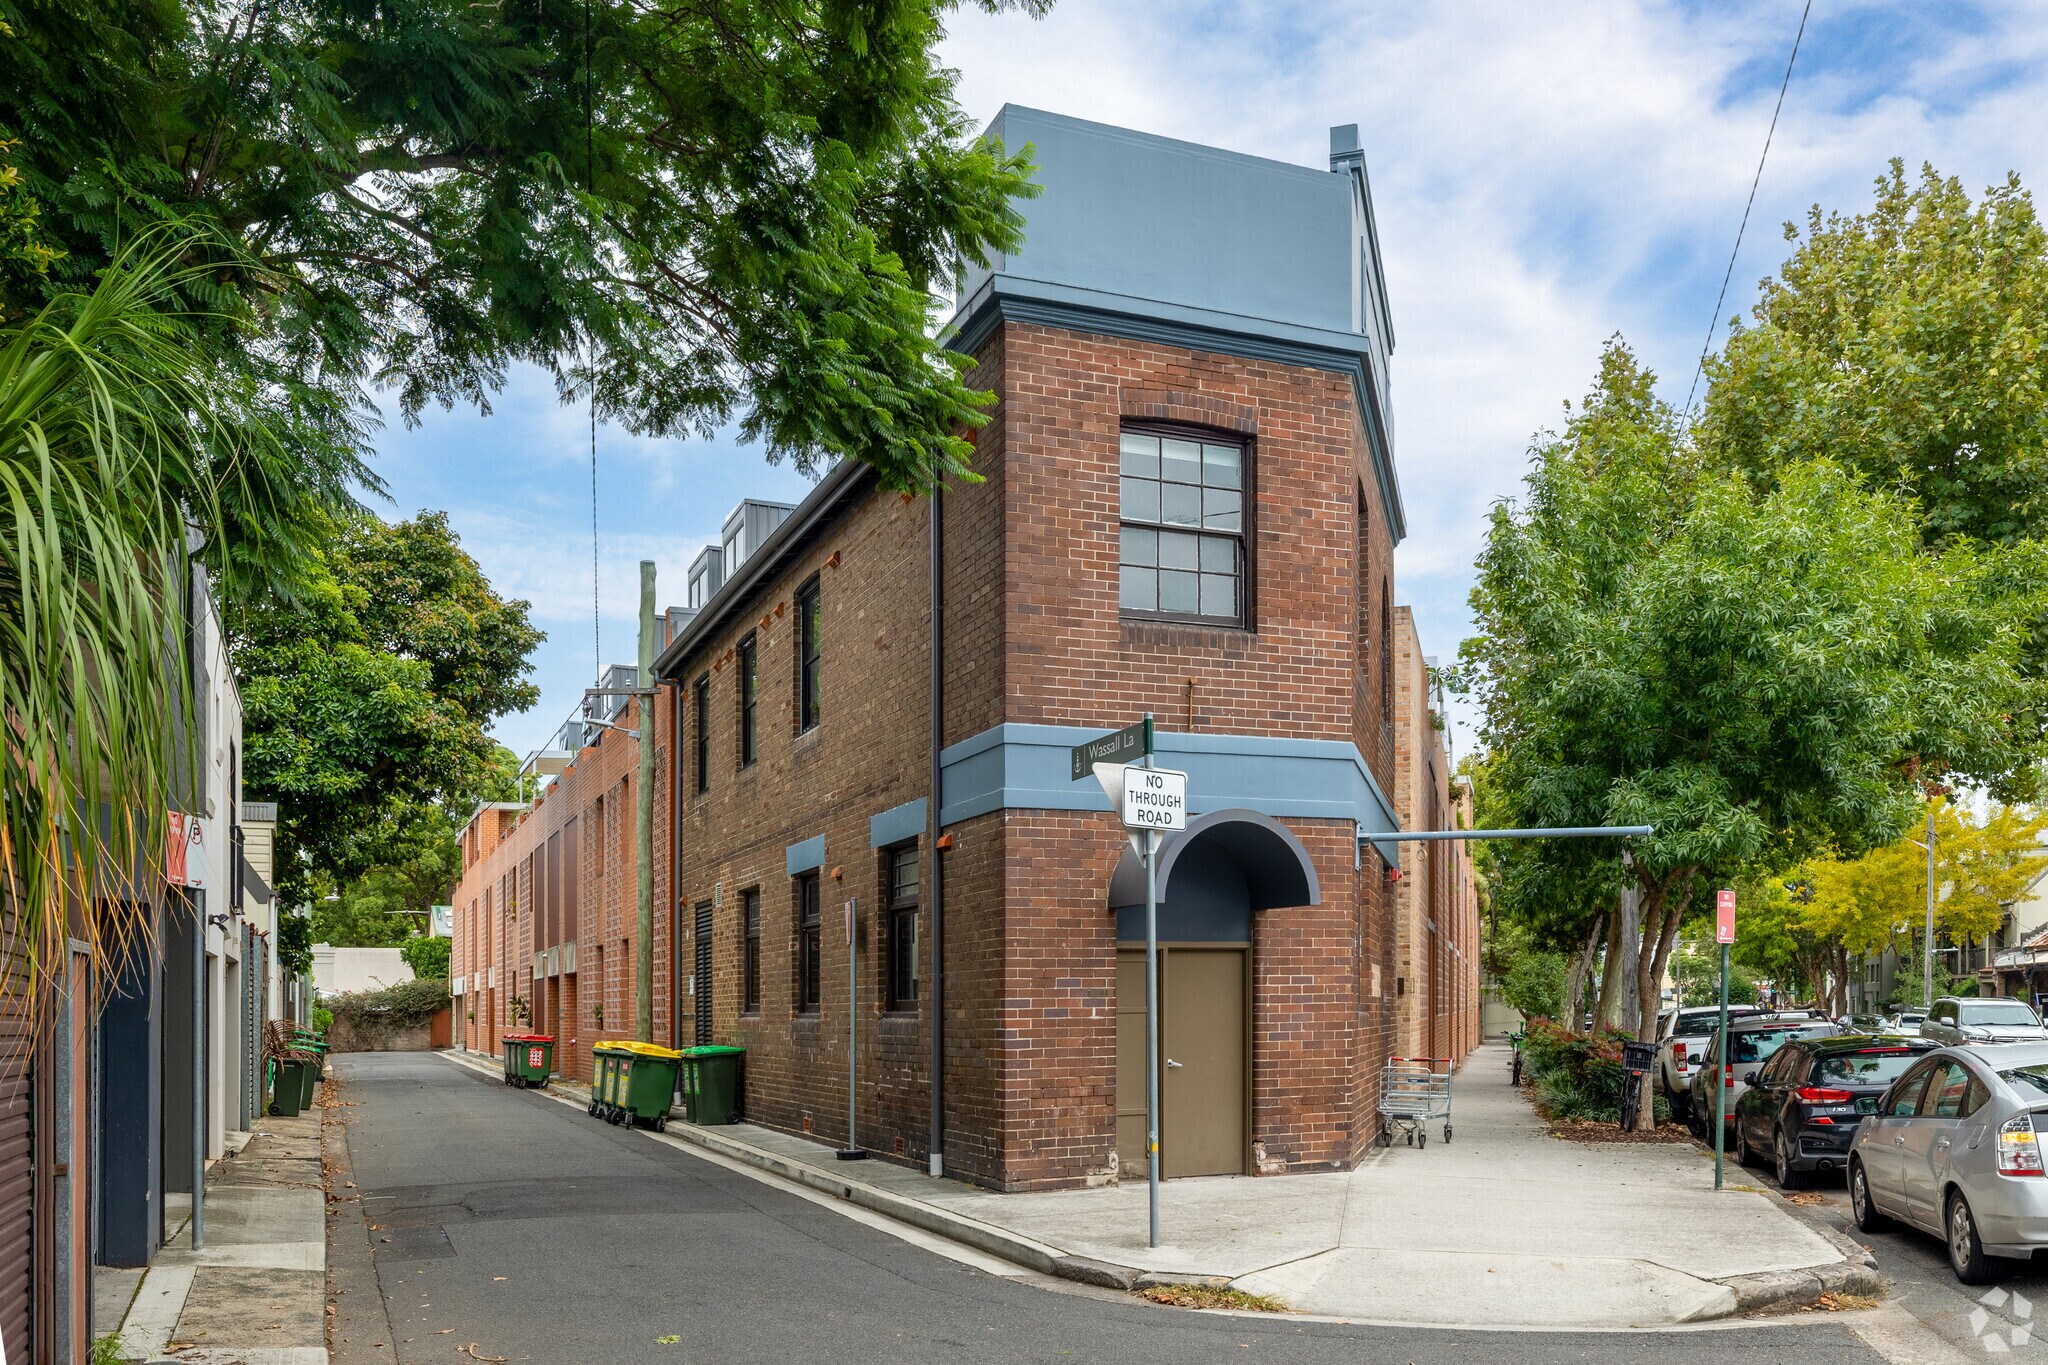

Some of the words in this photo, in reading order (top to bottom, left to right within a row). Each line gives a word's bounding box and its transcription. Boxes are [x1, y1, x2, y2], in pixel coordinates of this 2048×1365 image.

[1088, 735, 1120, 760] Wassall
[1123, 733, 1134, 748] La
[1146, 775, 1163, 789] NO
[1129, 790, 1181, 808] THROUGH
[1137, 809, 1172, 825] ROAD
